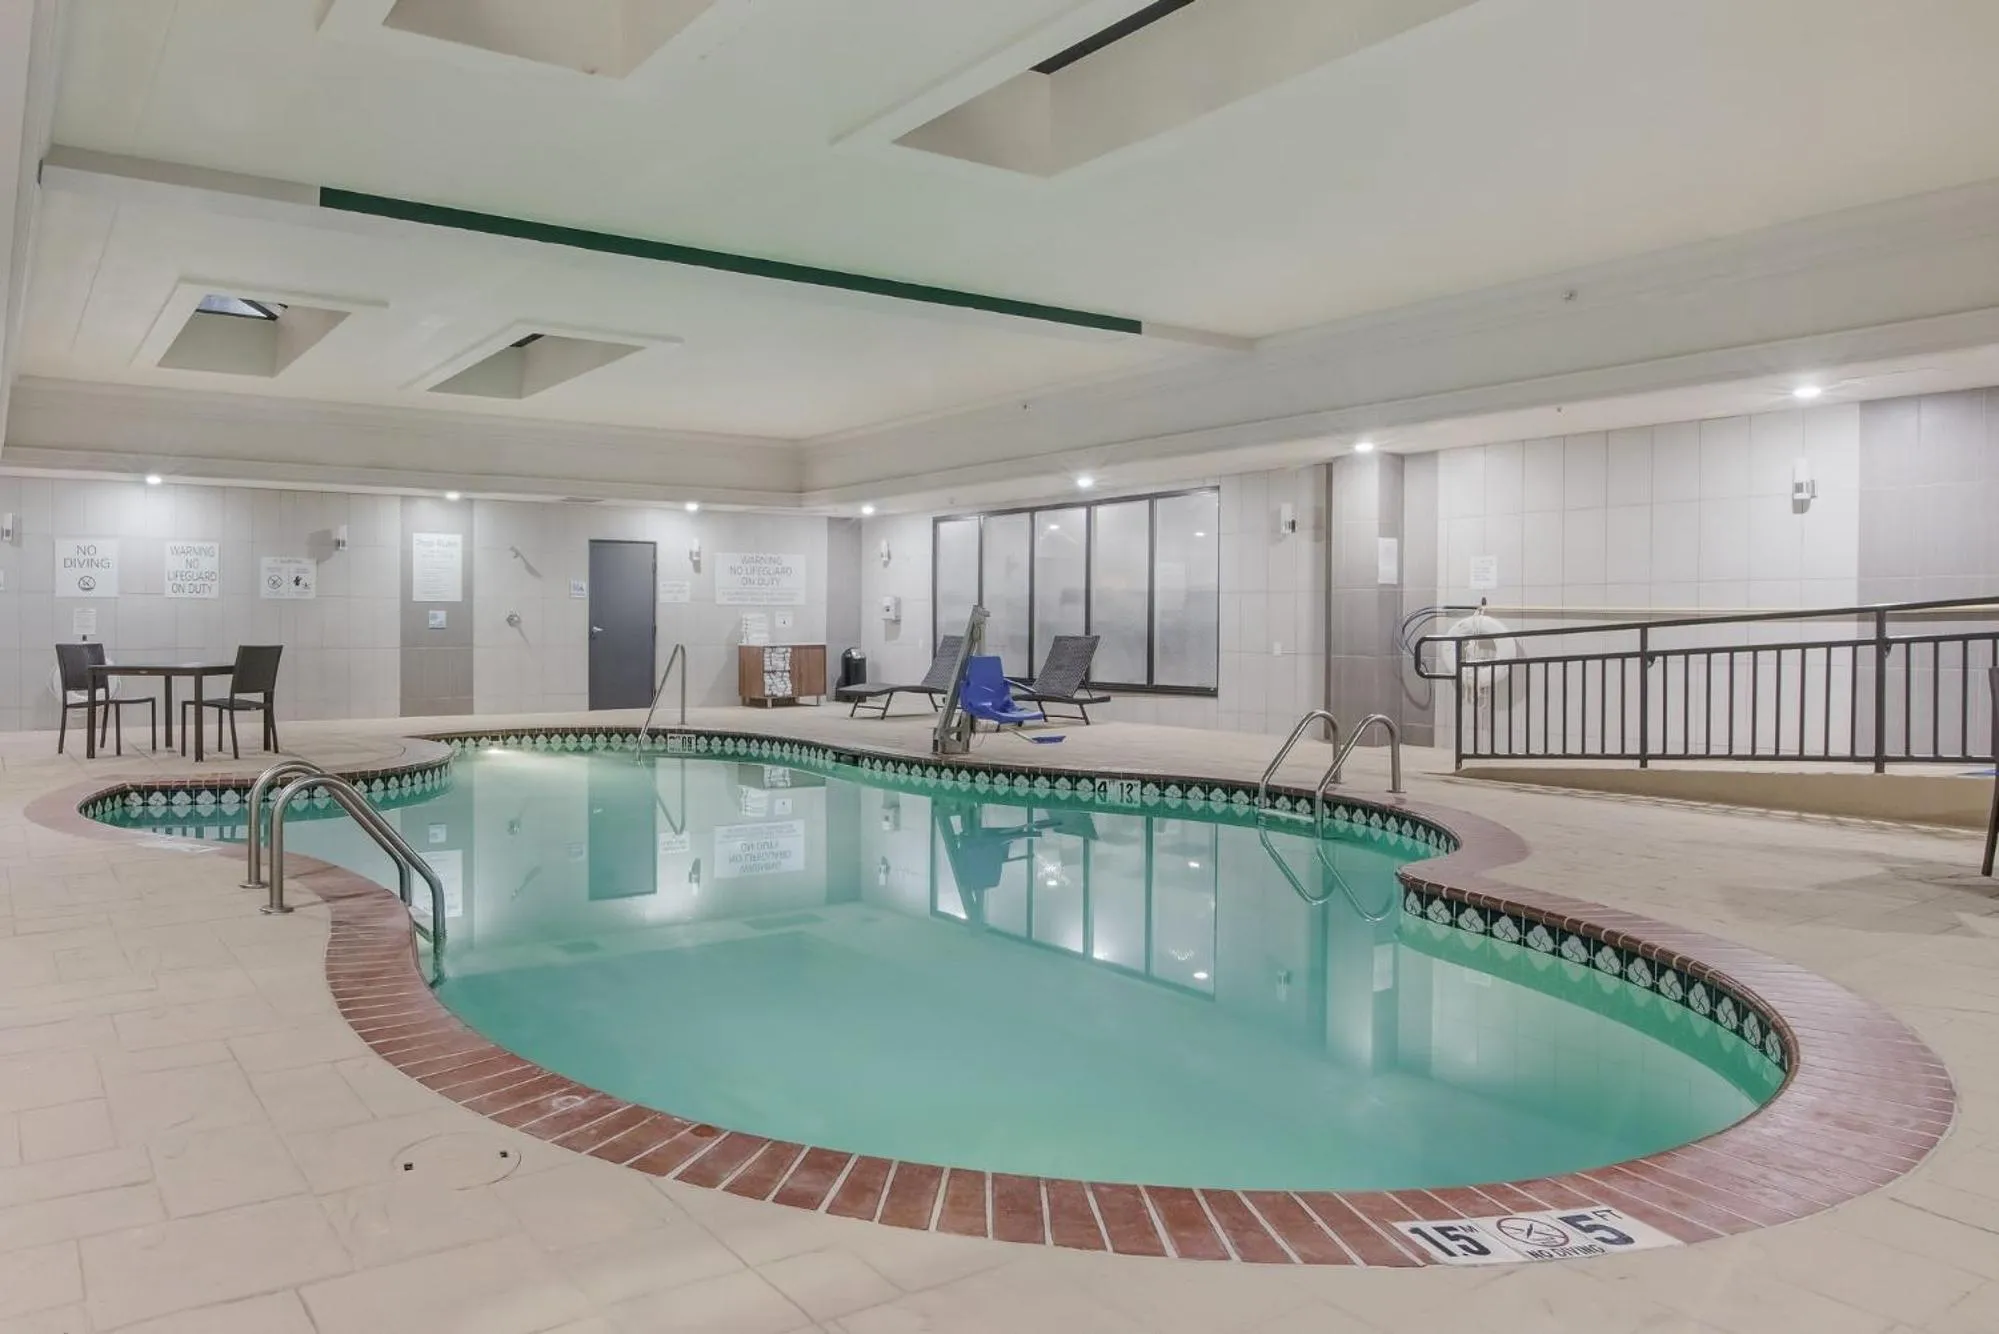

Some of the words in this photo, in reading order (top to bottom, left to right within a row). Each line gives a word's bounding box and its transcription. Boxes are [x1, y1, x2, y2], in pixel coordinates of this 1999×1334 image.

[76, 545, 97, 556] NO
[63, 557, 112, 569] DIVING
[1592, 1209, 1623, 1221] FT
[1557, 1214, 1635, 1246] 5
[1526, 1249, 1553, 1259] NO
